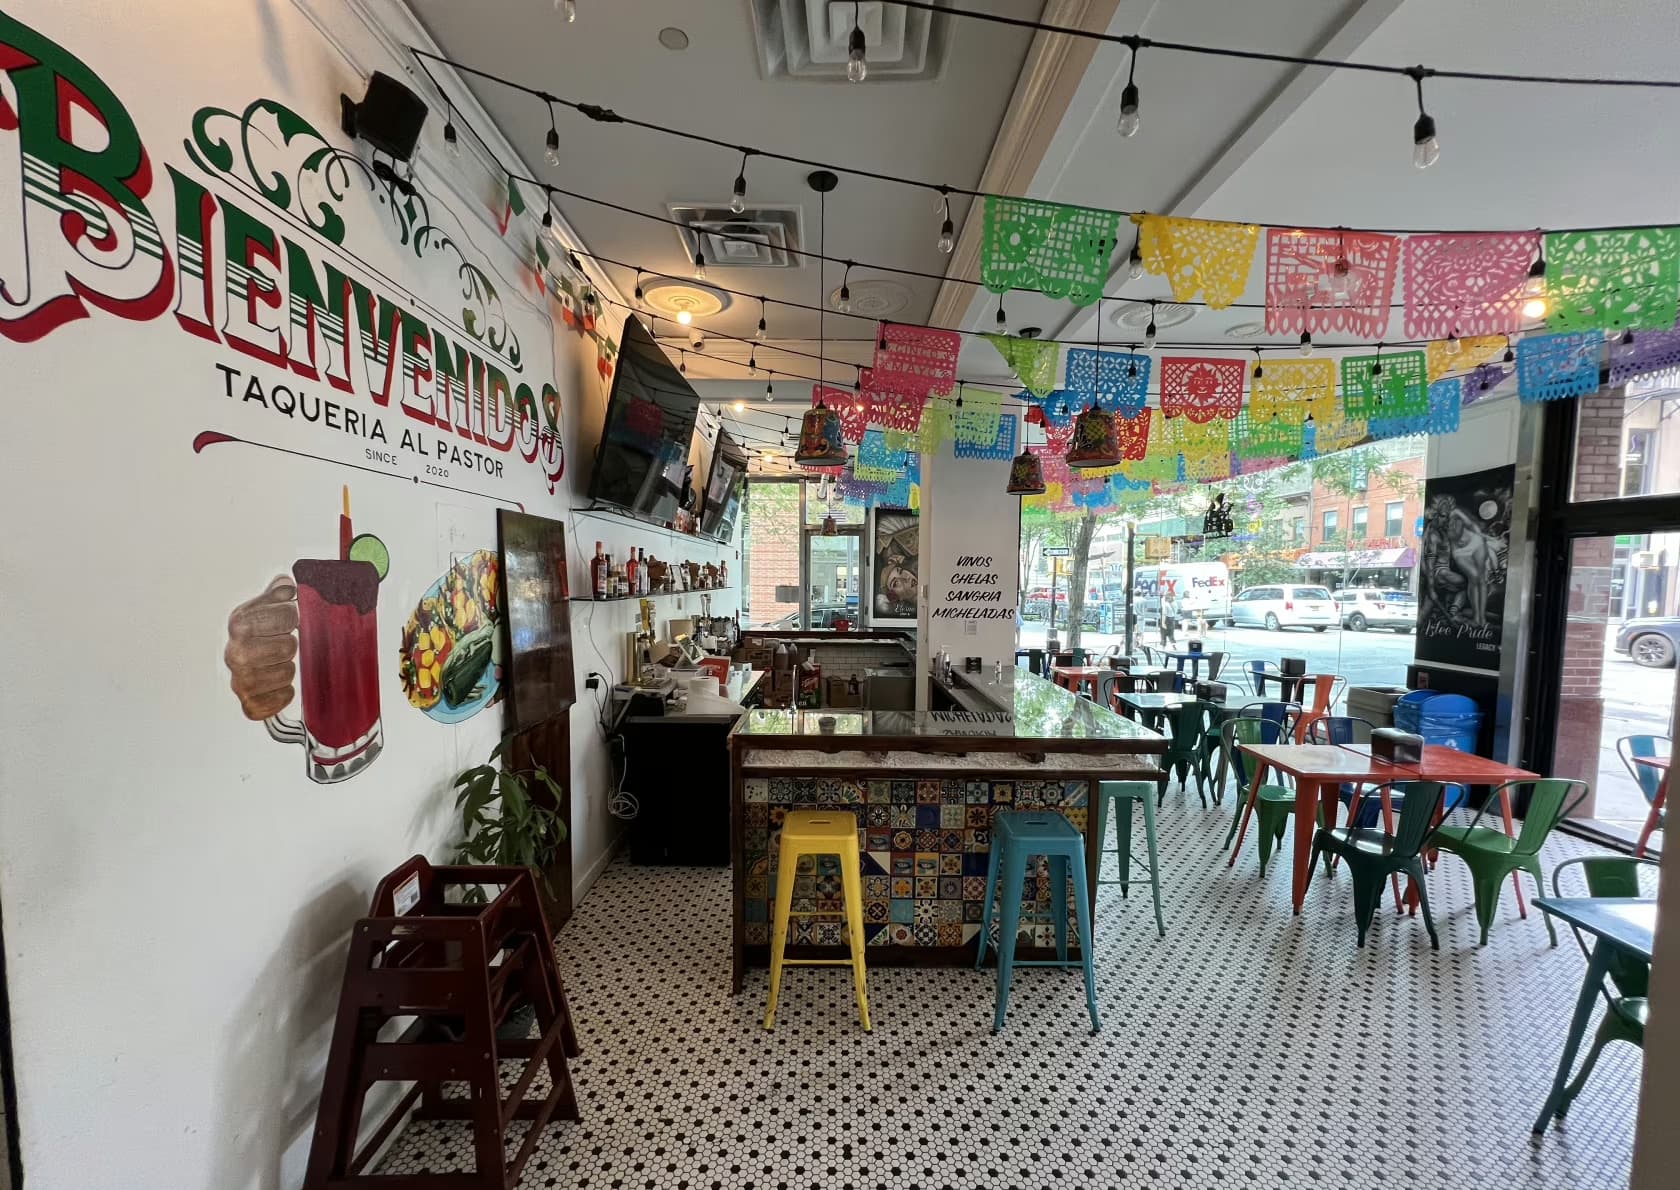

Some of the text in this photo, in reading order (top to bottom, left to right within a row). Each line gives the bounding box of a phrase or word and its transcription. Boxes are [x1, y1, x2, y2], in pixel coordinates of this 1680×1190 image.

[215, 362, 504, 479] TAQUERIA AL PASTOR
[365, 448, 450, 478] SINCE 2020
[956, 555, 993, 568] VINOS
[950, 573, 999, 585] CHELAS
[1134, 570, 1178, 597] FedEx
[1192, 576, 1225, 588] FedEx
[945, 590, 1002, 602] SANGRIA
[932, 607, 1015, 619] MICHELADAS
[1456, 622, 1494, 639] Pride
